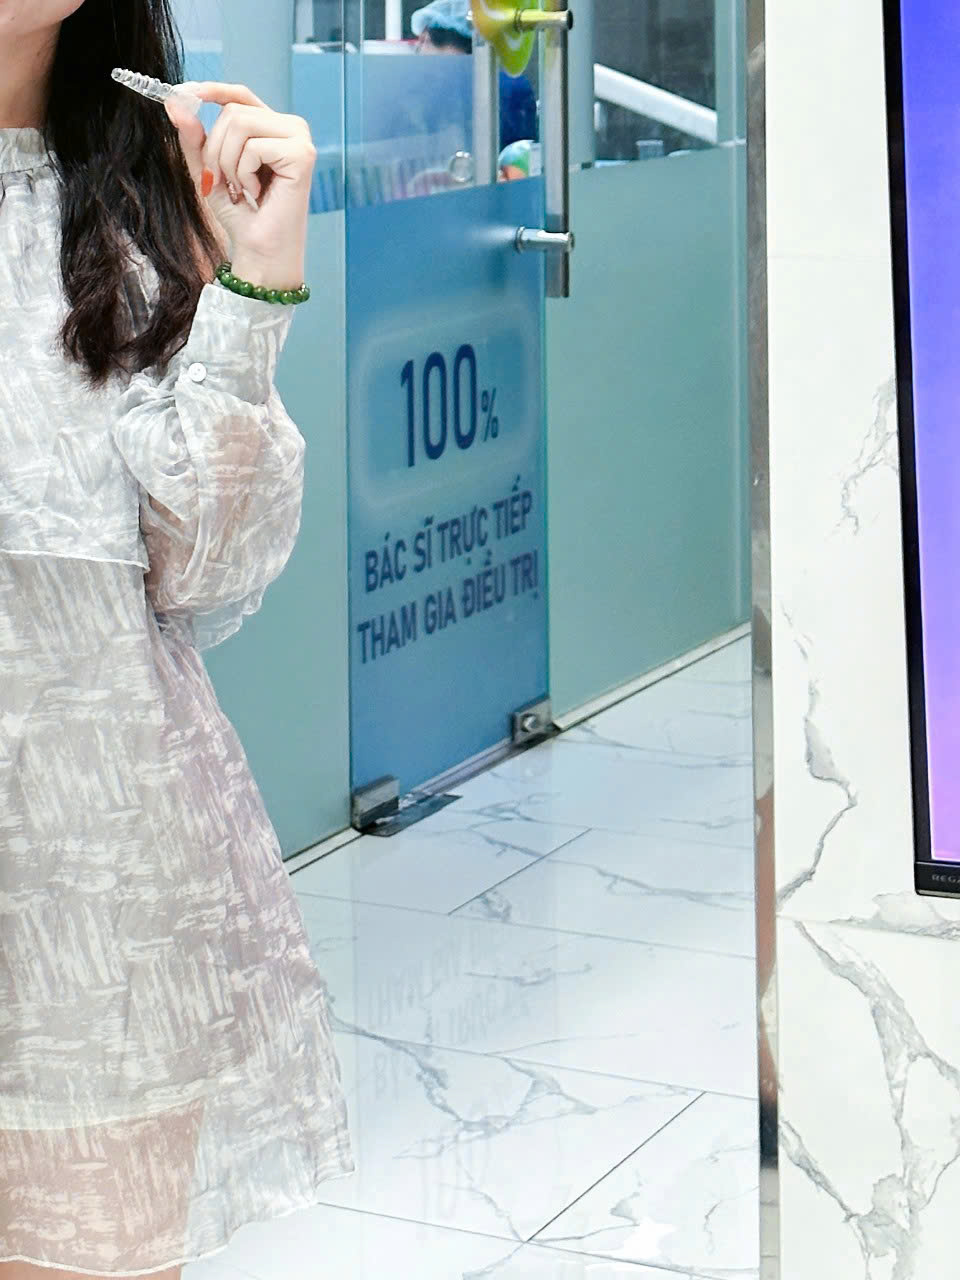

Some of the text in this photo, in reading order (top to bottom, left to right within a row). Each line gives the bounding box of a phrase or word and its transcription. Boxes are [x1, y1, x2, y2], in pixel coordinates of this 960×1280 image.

[400, 343, 499, 468] 100%
[363, 474, 533, 594] BÁC SĨ TRỰC TIẾP
[357, 548, 539, 665] THAM GIA ĐIỀU TRỊ
